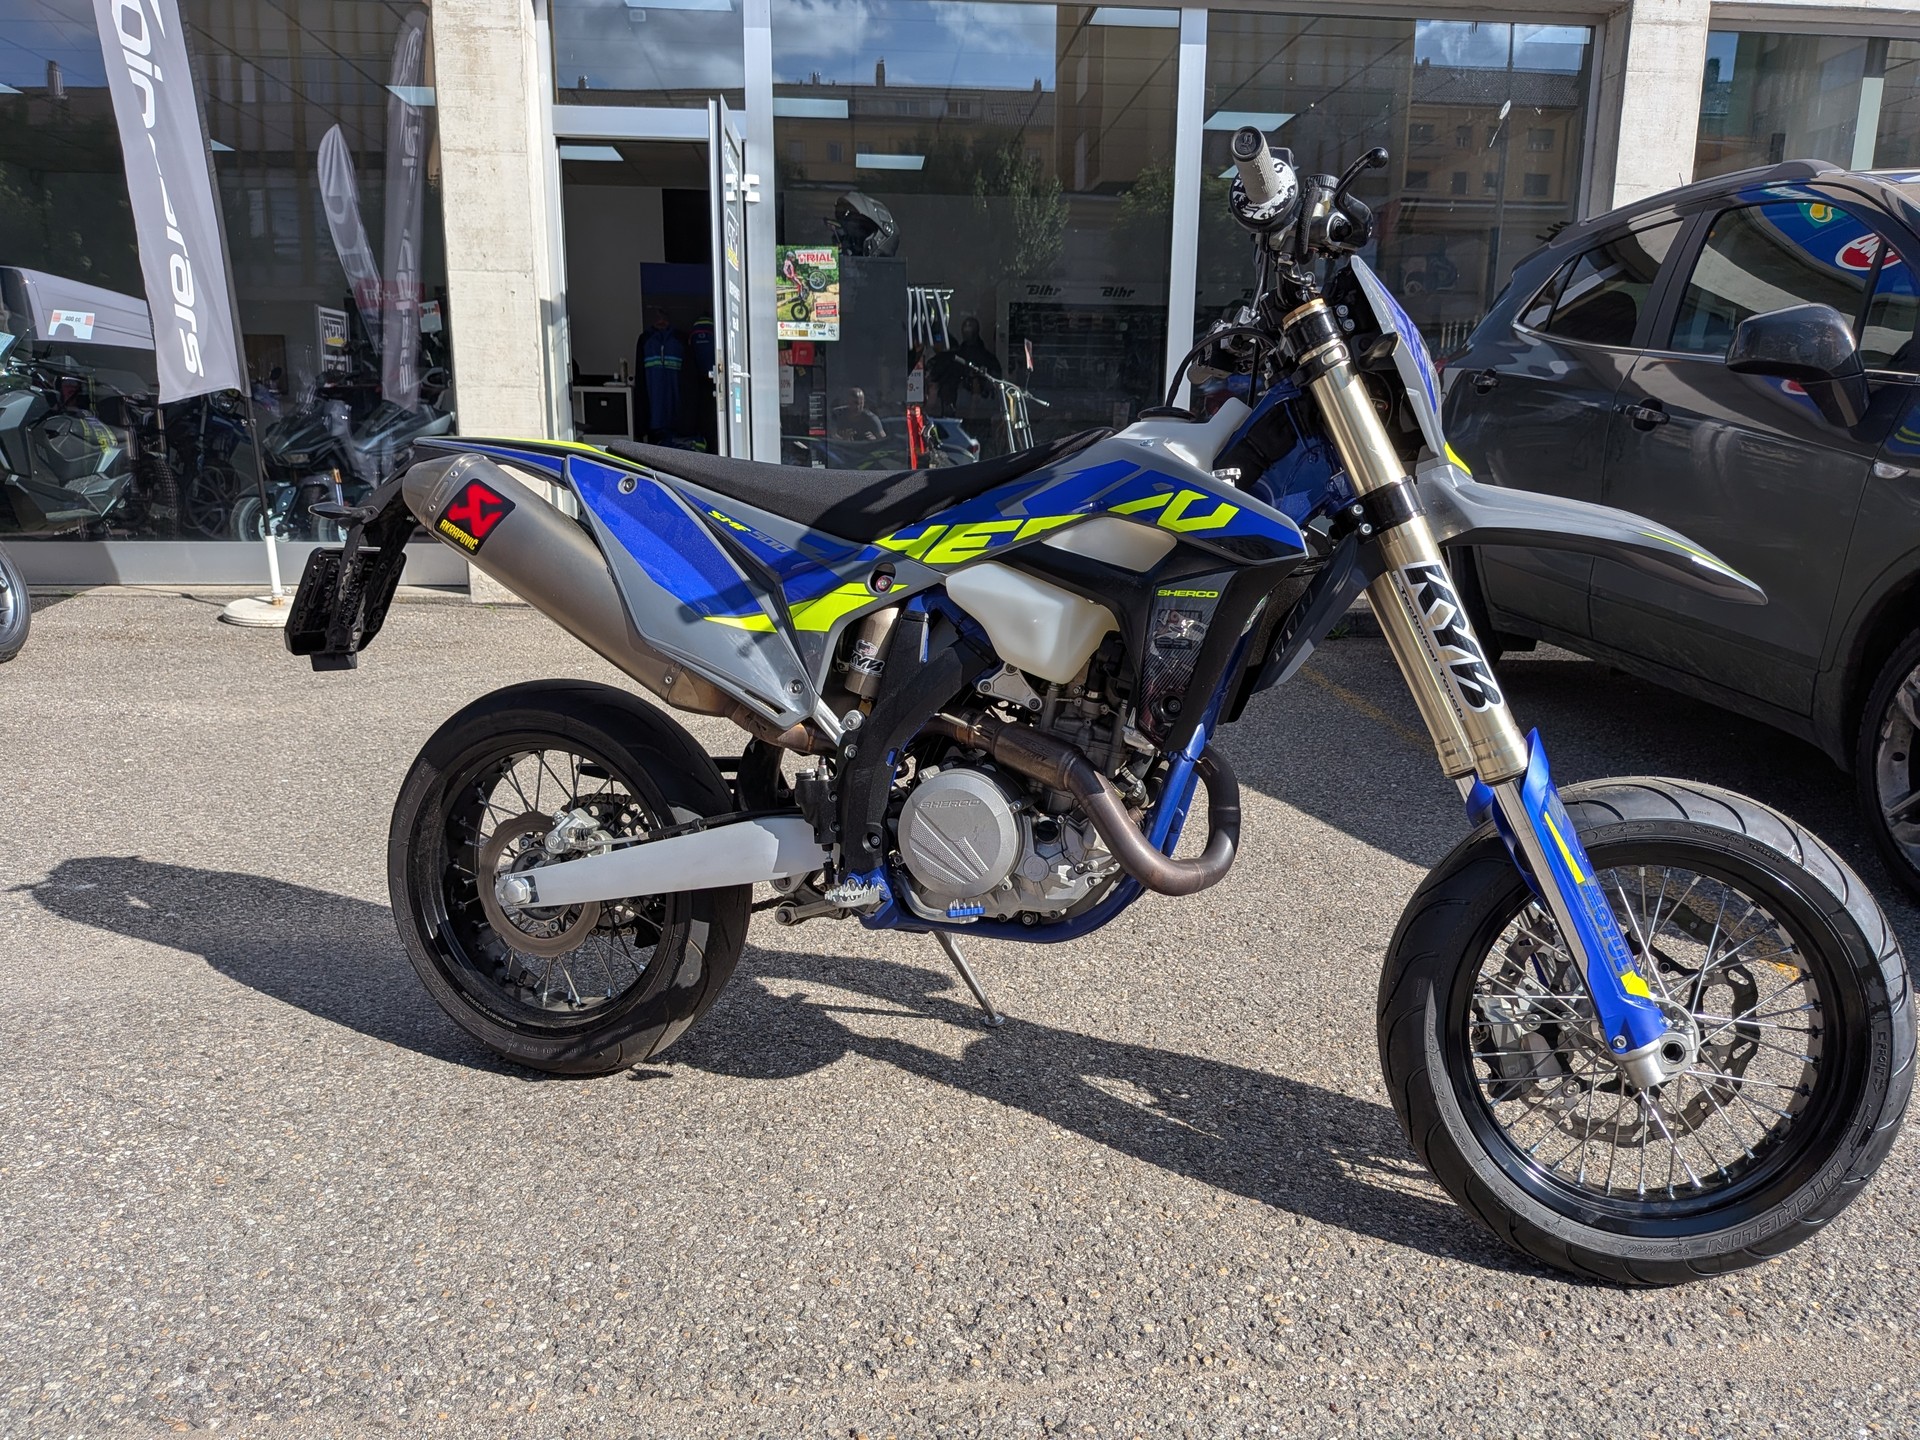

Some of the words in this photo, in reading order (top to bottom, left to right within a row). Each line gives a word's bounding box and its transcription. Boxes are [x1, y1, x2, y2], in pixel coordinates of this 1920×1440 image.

[1026, 284, 1062, 296] Bihr
[1100, 286, 1136, 298] Bihr
[708, 510, 751, 532] SMF
[749, 530, 792, 553] 500
[1157, 589, 1219, 598] SHERCO
[1402, 561, 1504, 711] KYB
[1440, 667, 1464, 719] Touch
[919, 799, 981, 809] SHERCO
[1582, 884, 1630, 972] MOTUL
[1707, 1159, 1844, 1254] MICHELIN
